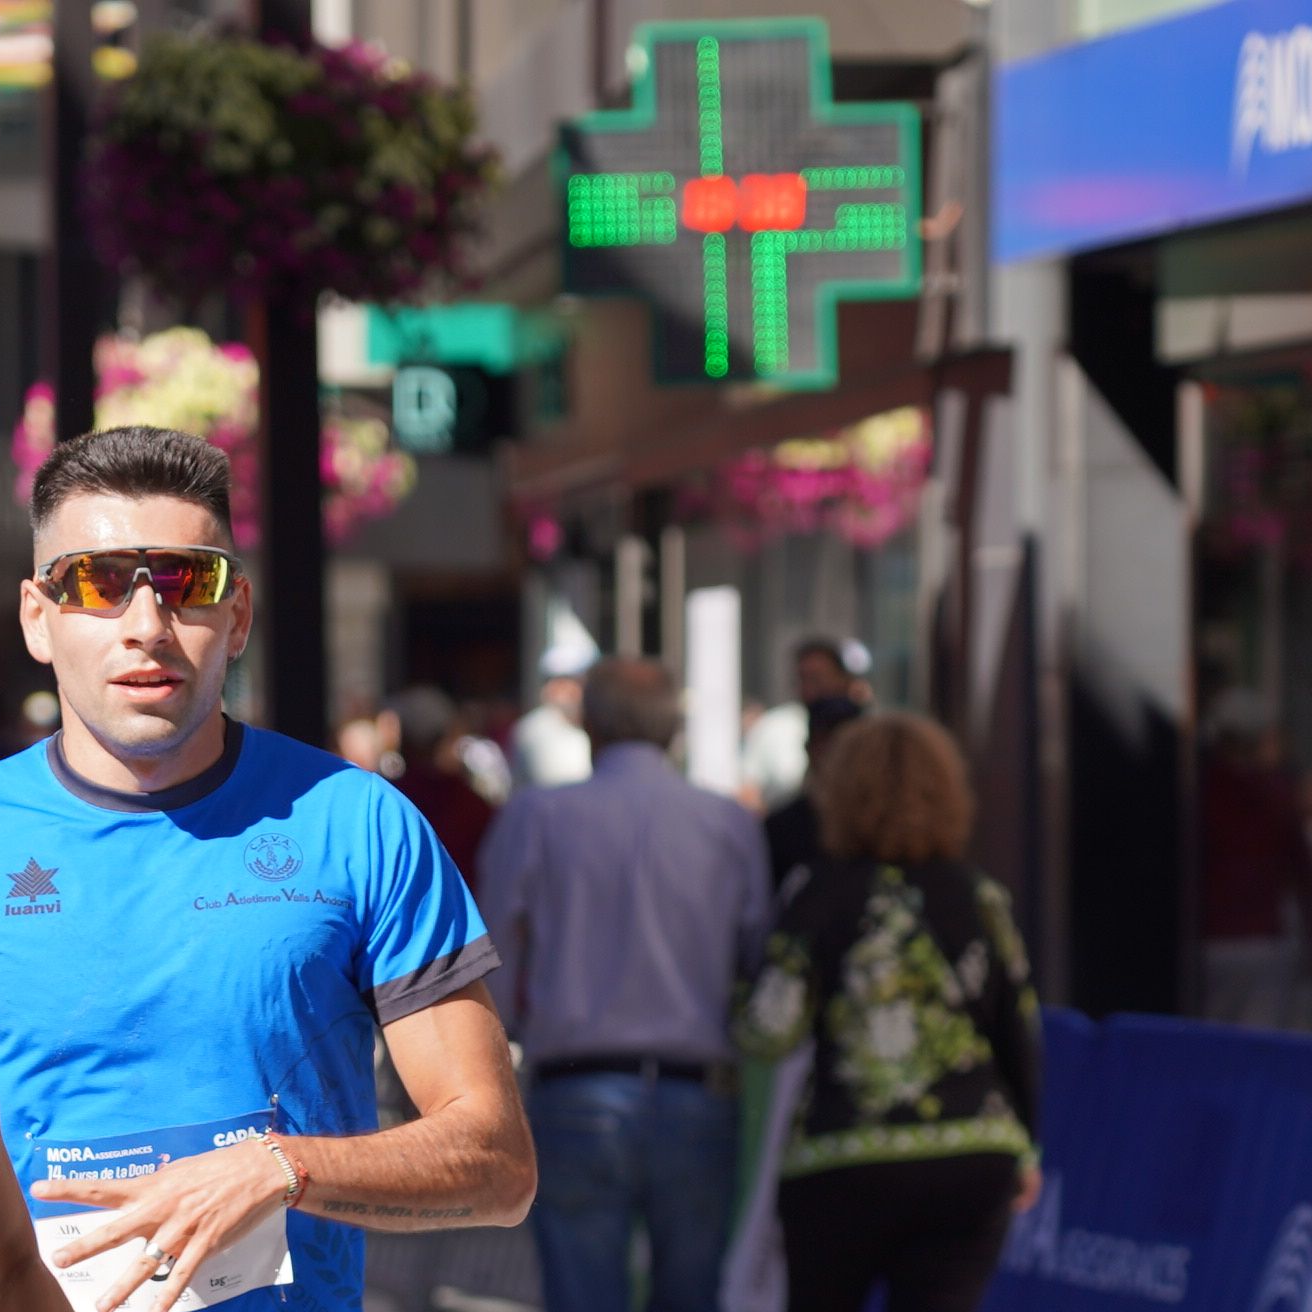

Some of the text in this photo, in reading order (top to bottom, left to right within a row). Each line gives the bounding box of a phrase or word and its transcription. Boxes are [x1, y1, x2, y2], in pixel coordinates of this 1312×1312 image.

[4, 900, 61, 916] luanvi
[193, 896, 222, 911] Club
[225, 892, 281, 906] Atletisme
[47, 1145, 153, 1163] MORA ASSEGURANCES
[100, 1166, 114, 1179] de
[129, 1163, 155, 1178] Dona
